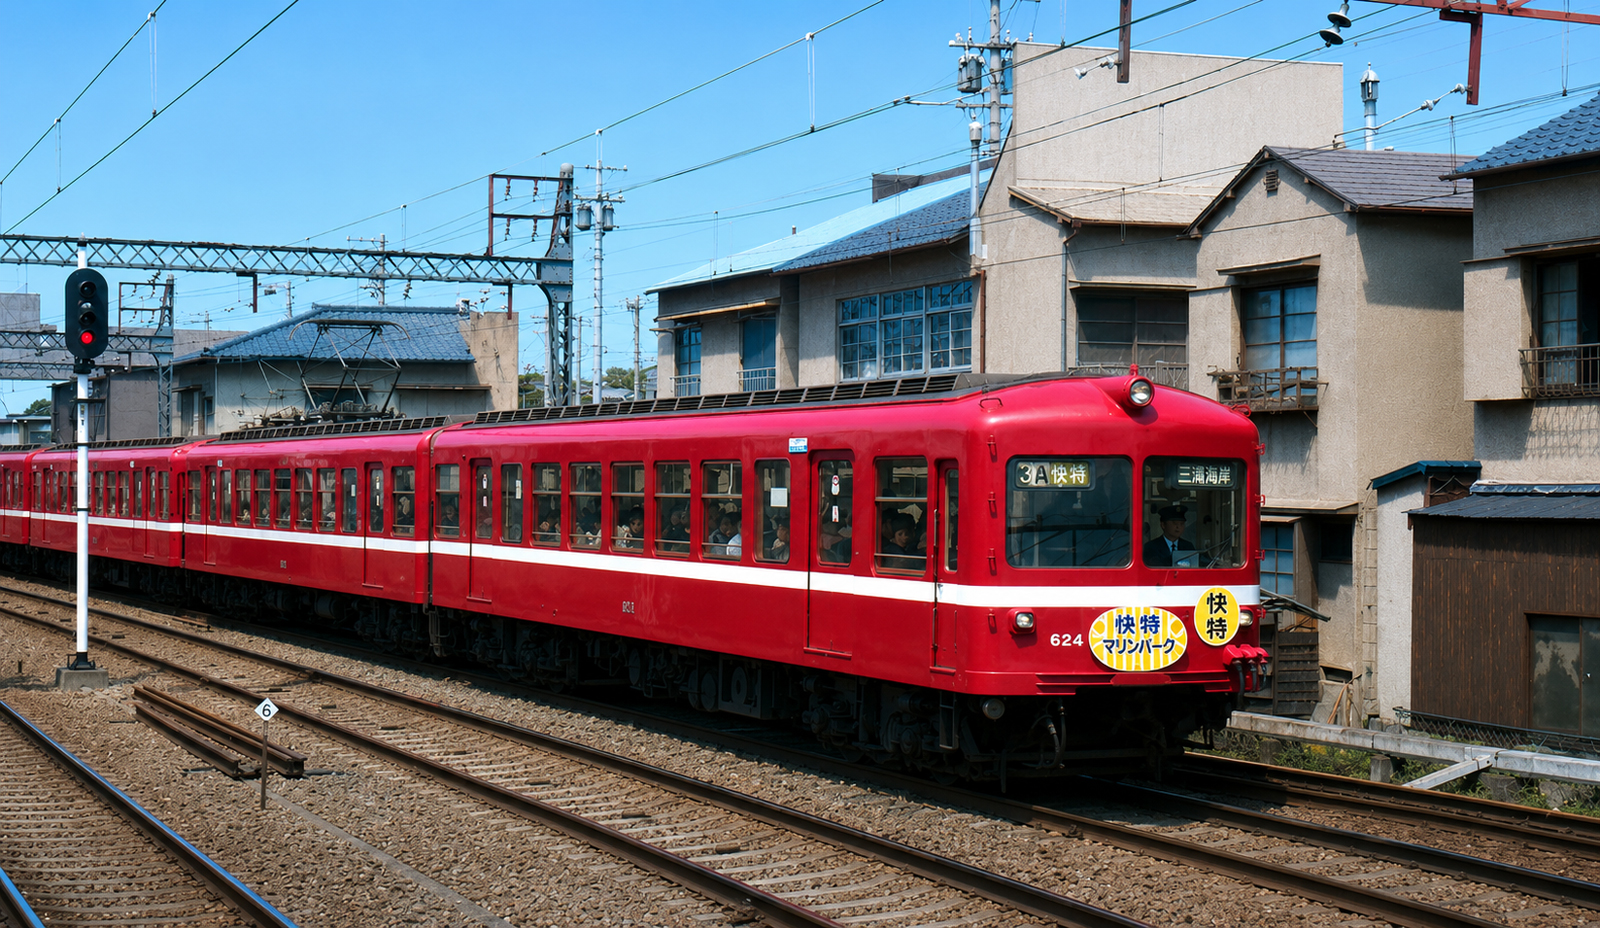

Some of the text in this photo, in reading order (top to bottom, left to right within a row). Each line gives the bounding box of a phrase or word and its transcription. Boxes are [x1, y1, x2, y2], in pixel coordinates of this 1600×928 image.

[1115, 614, 1160, 635] 快特
[1206, 592, 1228, 641] 快特
[1050, 634, 1084, 646] 624
[262, 703, 271, 717] 6
